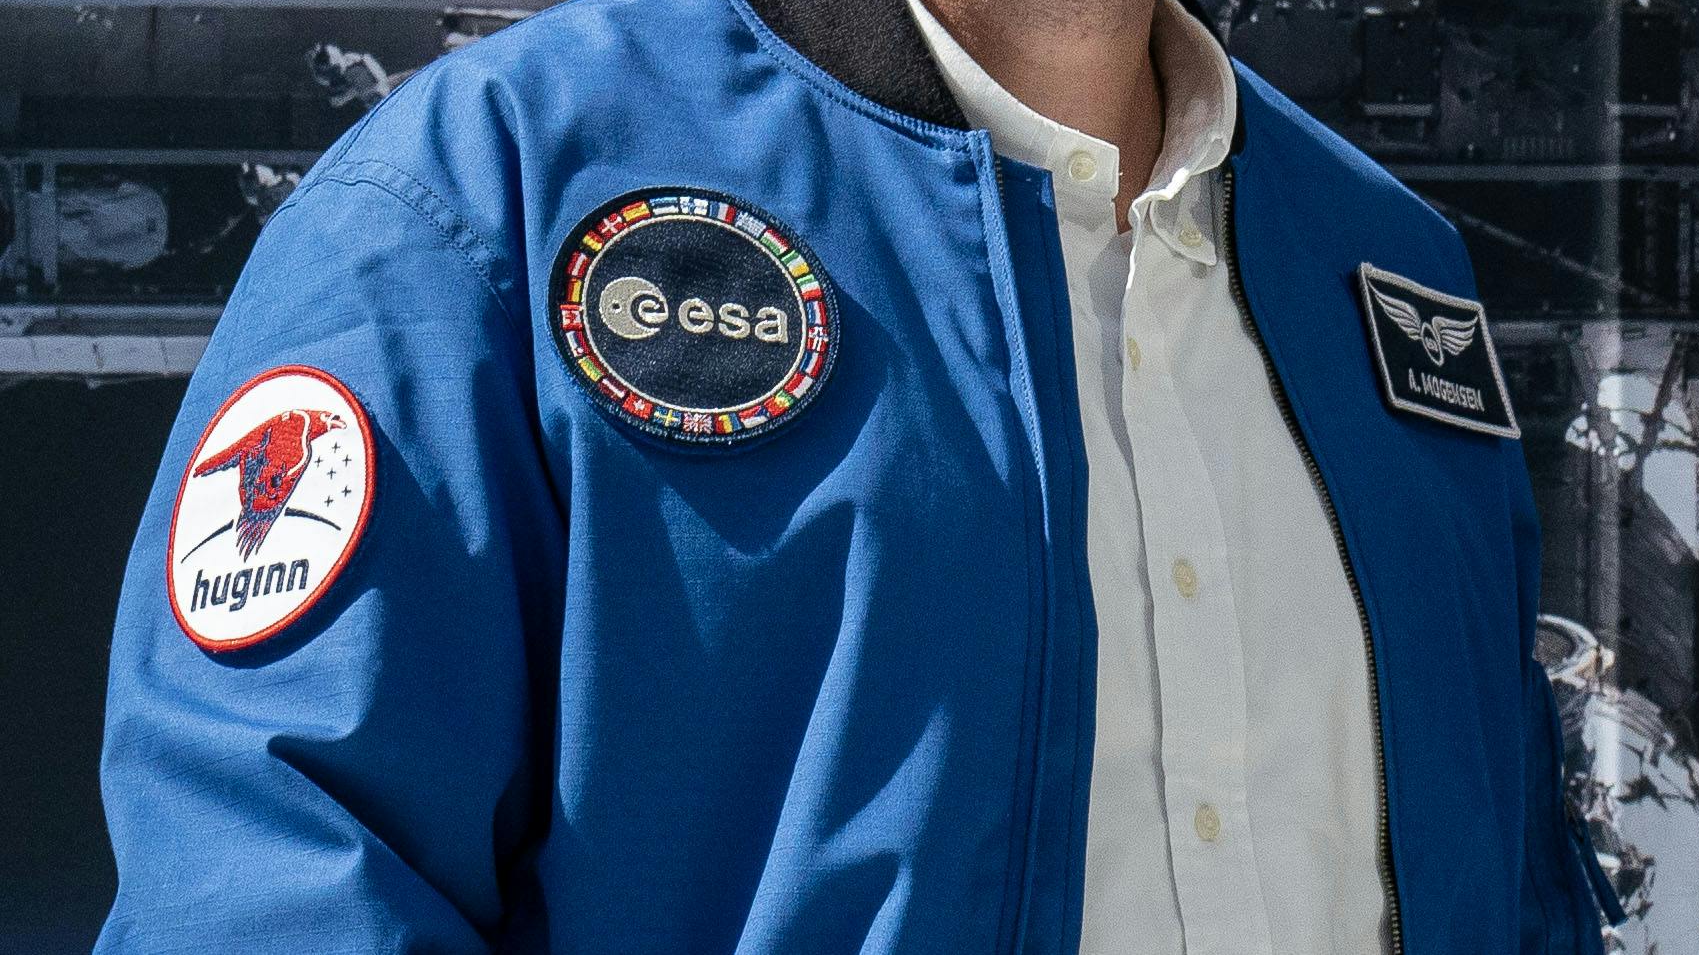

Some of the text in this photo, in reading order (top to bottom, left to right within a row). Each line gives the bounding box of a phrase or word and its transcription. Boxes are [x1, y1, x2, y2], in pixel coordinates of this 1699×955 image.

[678, 298, 788, 344] esa
[1408, 367, 1485, 412] A. MOGENSEN
[190, 558, 310, 612] huginn
